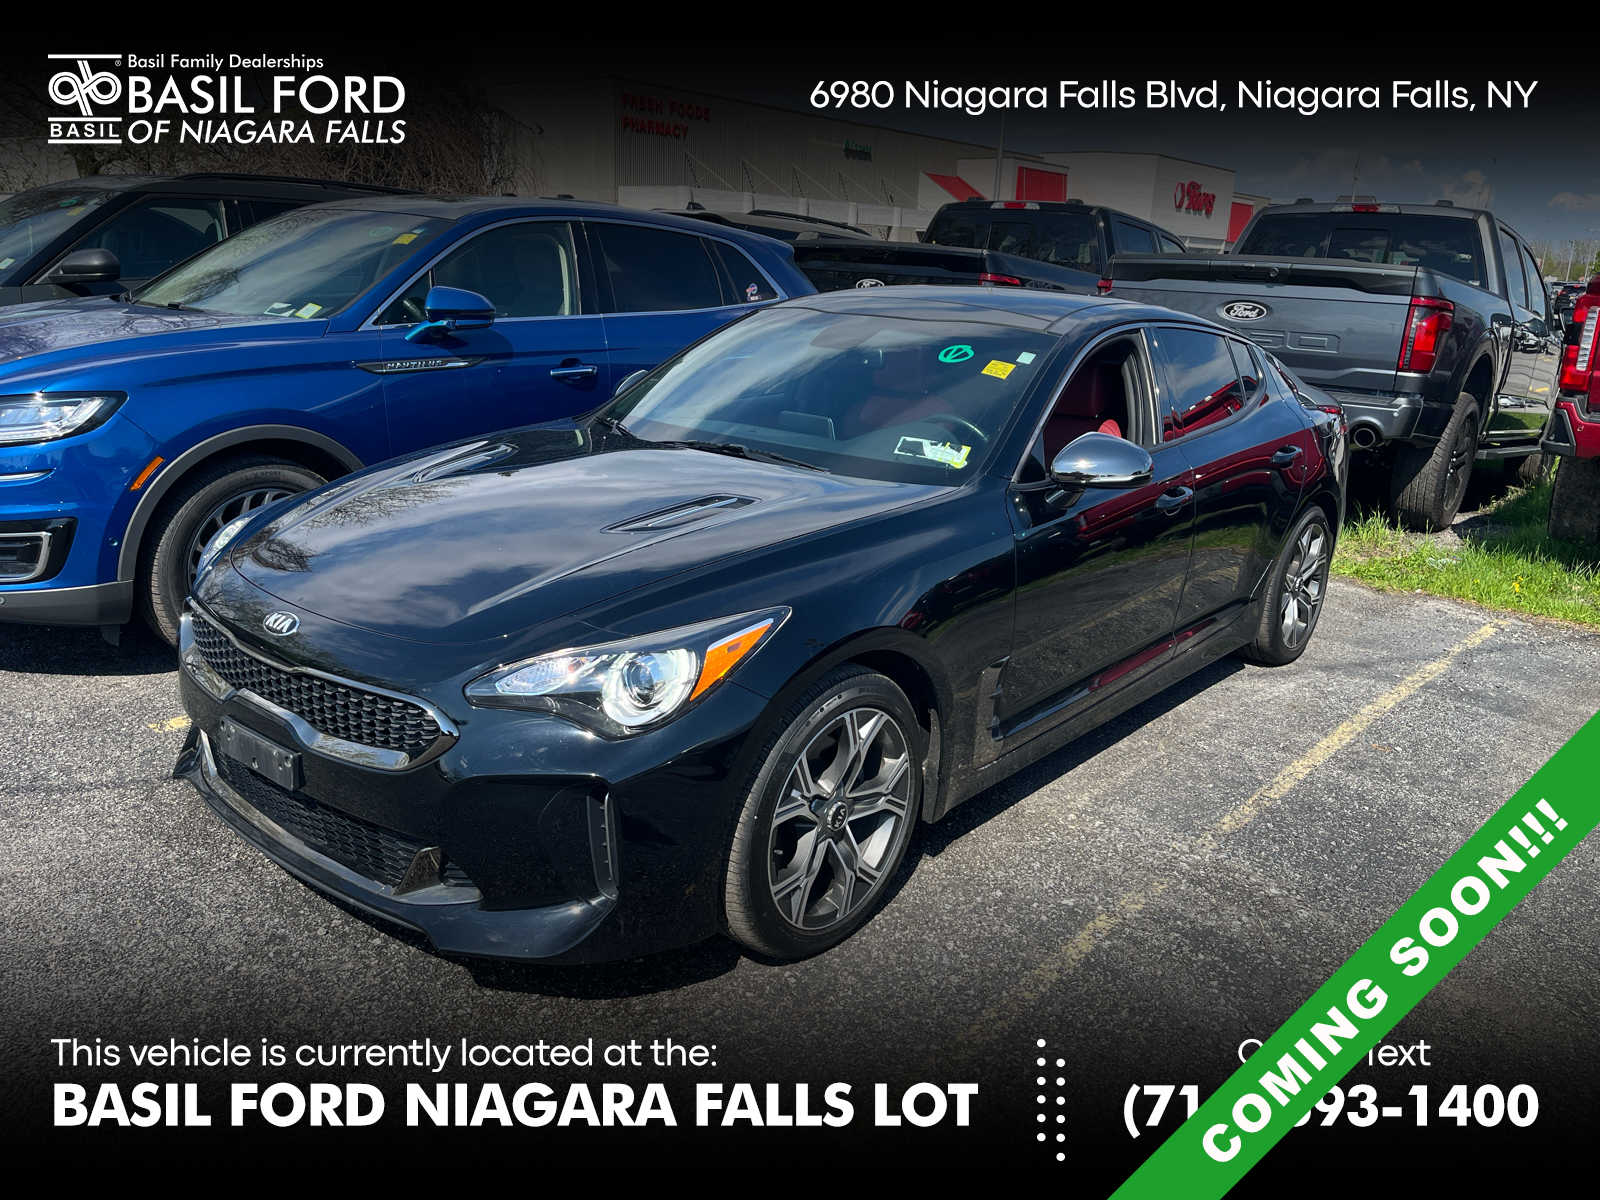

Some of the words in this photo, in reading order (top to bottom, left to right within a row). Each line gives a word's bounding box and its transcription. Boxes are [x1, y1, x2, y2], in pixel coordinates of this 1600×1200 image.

[1227, 303, 1262, 318] Ford
[386, 359, 444, 370] NAUTILUS
[264, 612, 295, 634] KIA
